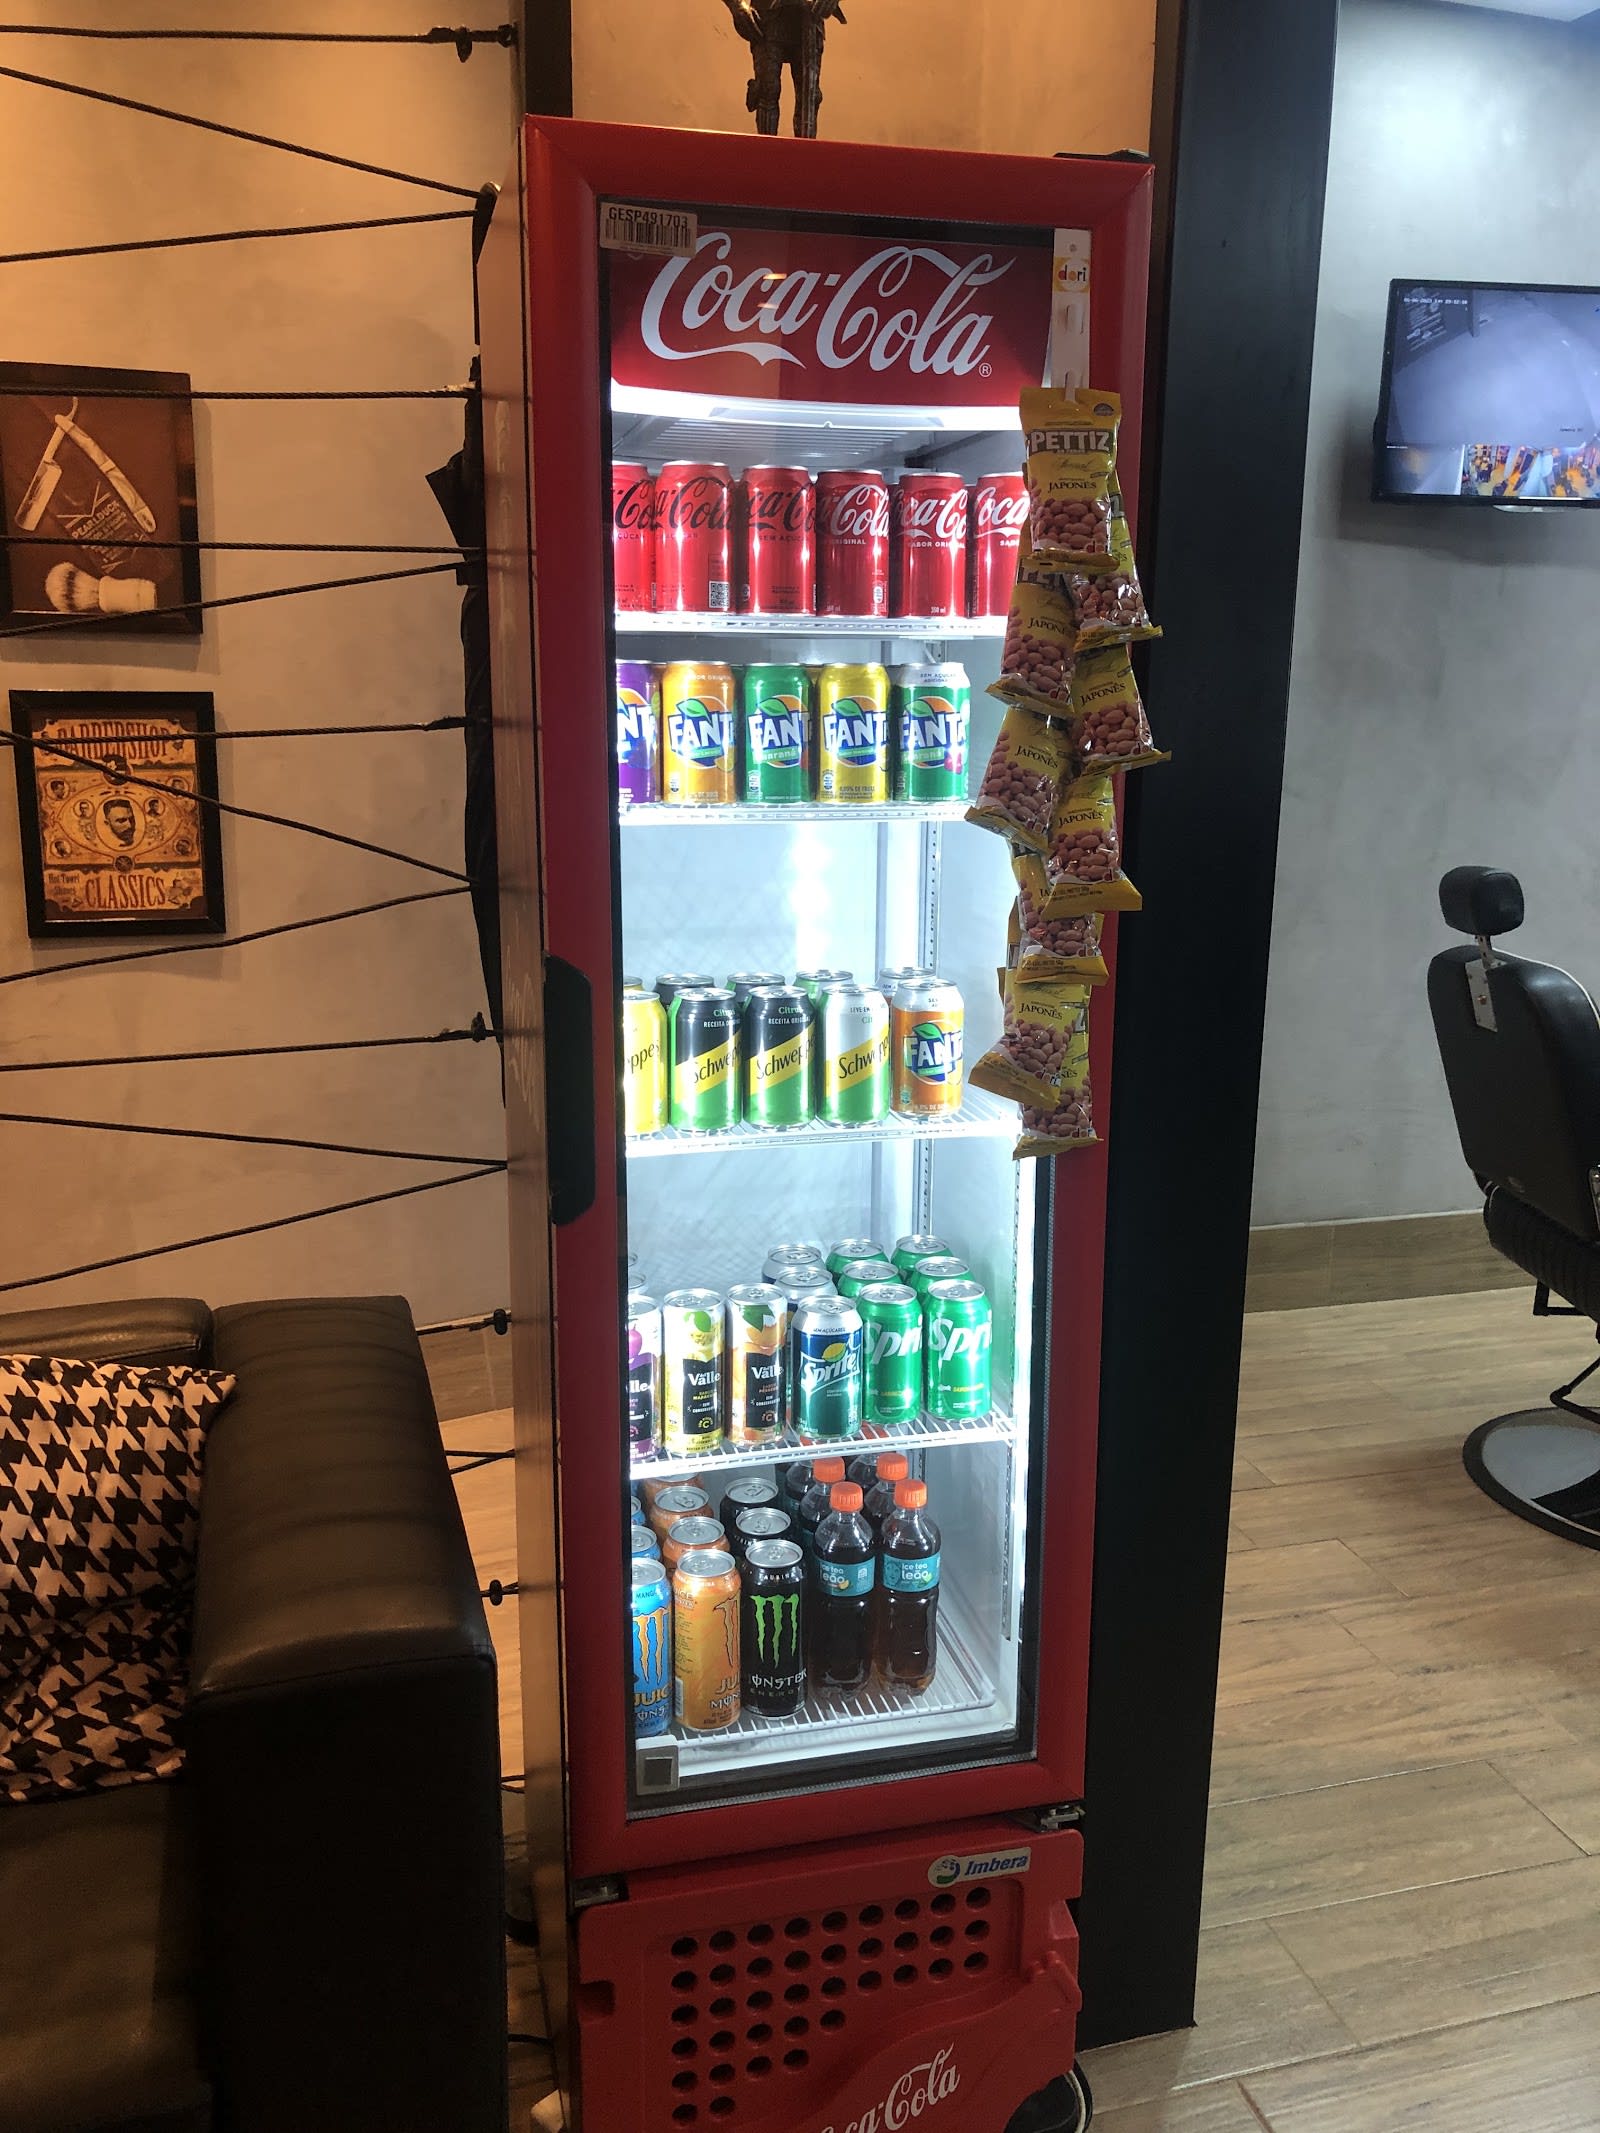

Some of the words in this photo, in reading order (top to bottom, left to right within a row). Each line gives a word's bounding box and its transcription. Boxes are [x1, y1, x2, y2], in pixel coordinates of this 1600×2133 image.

[609, 207, 688, 229] GESP491703
[1058, 264, 1086, 281] dori
[641, 232, 1017, 376] Coca-Cola
[1030, 431, 1110, 453] PETTIZ
[85, 873, 166, 909] CLASSICS
[768, 1017, 790, 1025] RECEITA
[1019, 1002, 1063, 1020] JAPONÊS
[802, 1347, 859, 1387] Sprite
[902, 1568, 929, 1580] leão
[964, 1855, 1028, 1876] Imbera
